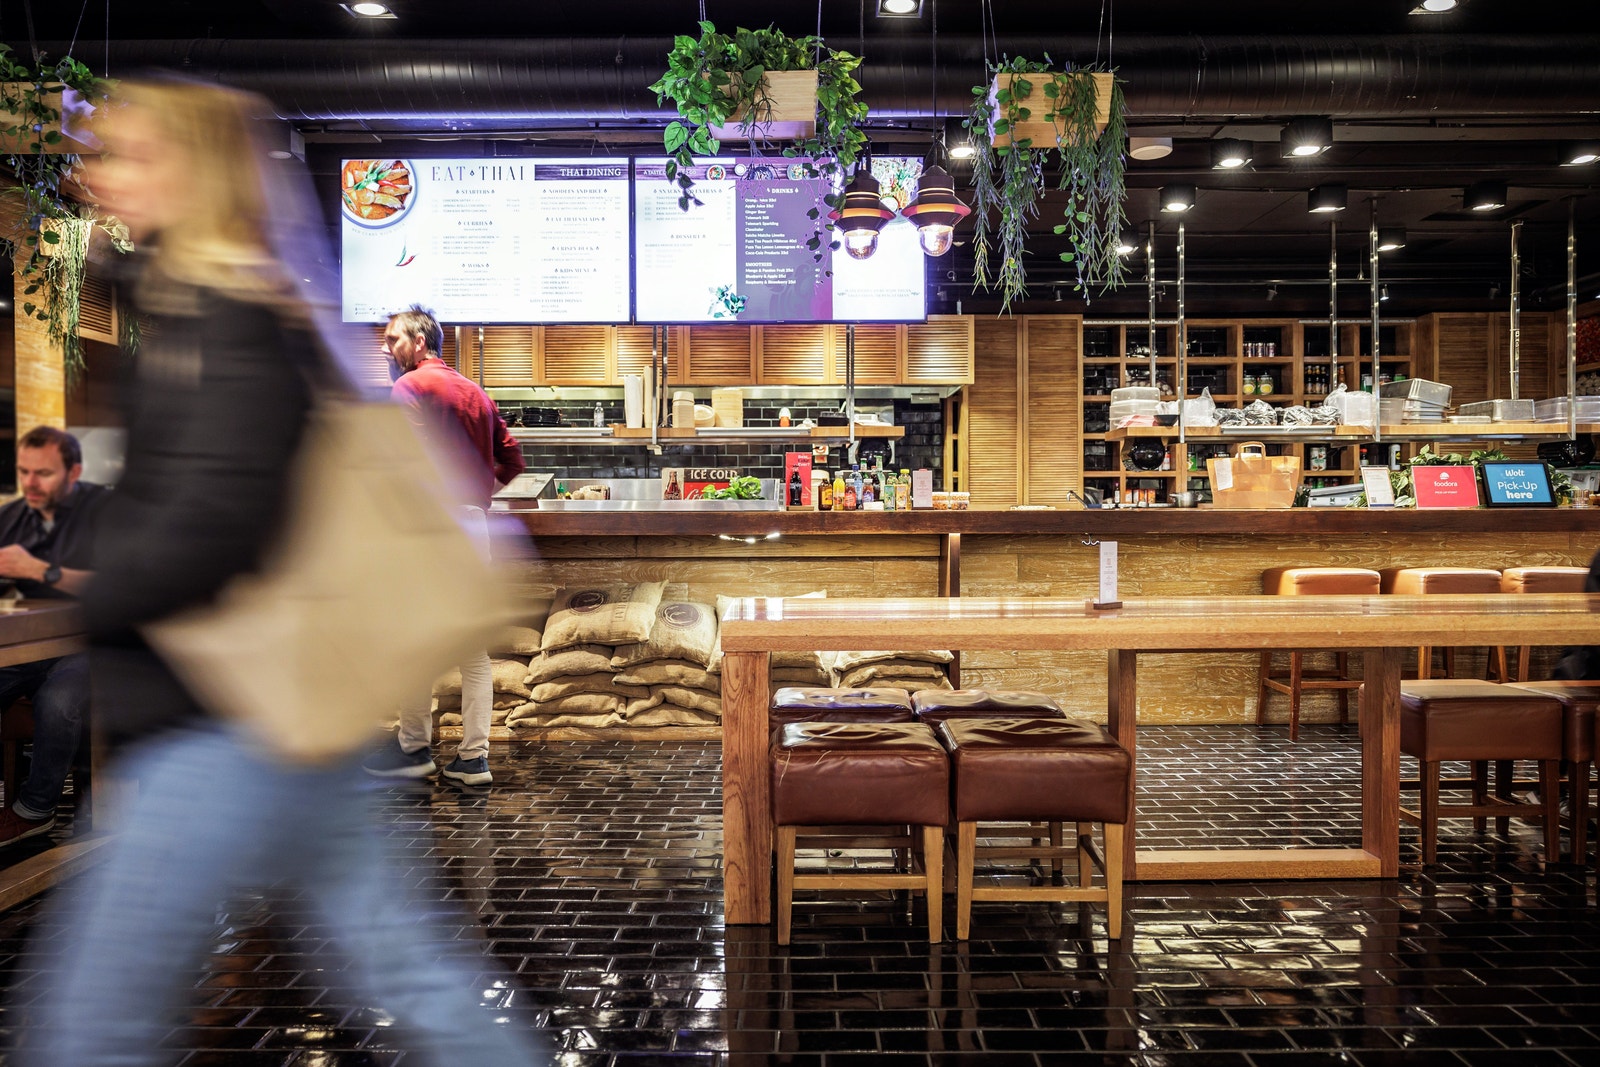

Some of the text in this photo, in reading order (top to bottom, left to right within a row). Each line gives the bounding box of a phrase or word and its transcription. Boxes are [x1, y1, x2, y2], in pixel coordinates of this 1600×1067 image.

[432, 165, 524, 181] EAT THAI
[560, 168, 621, 177] THAI DINING
[690, 469, 738, 480] ICE COLD
[1505, 469, 1525, 477] Wolt
[1497, 481, 1538, 491] Pick-Up
[1505, 490, 1533, 499] here
